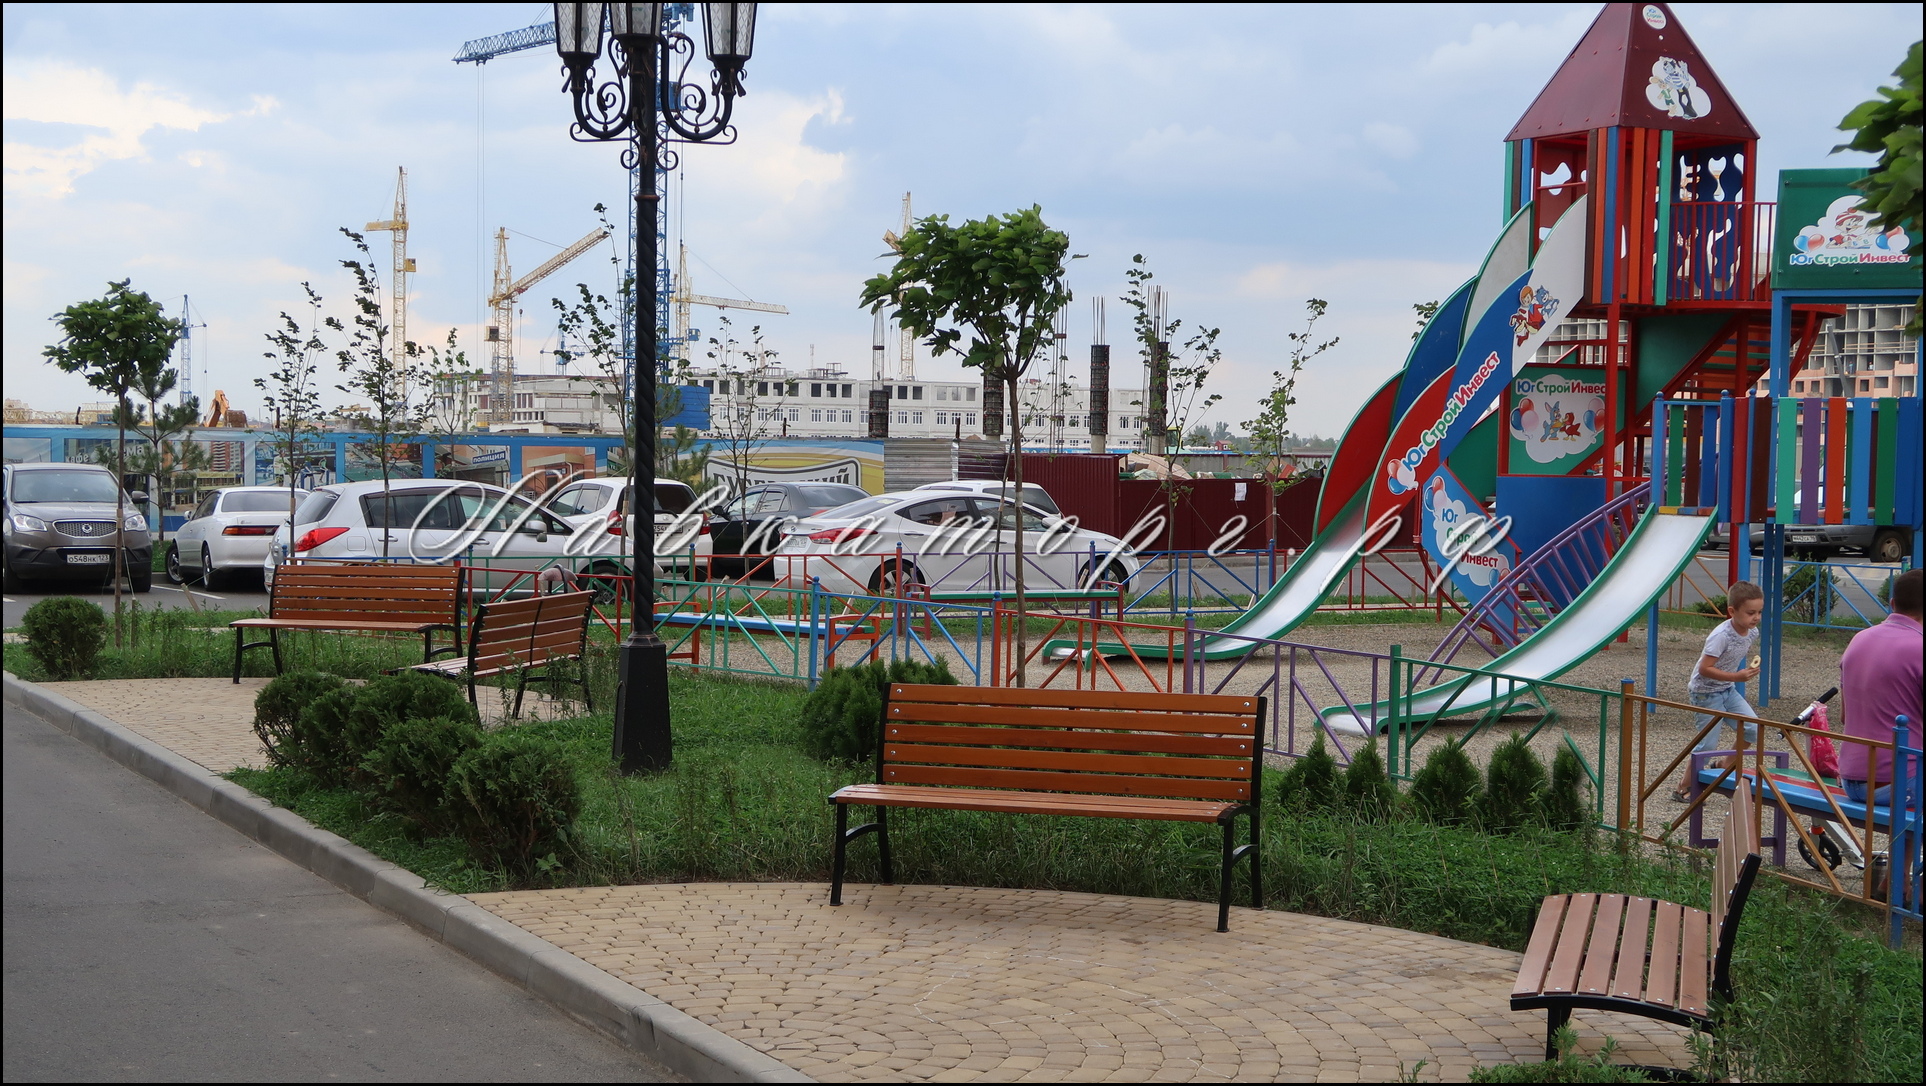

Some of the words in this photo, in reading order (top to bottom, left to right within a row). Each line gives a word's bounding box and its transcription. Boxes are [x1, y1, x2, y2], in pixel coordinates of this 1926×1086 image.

[1790, 252, 1911, 266] ЮгСтройИнвест
[1517, 380, 1606, 396] ЮгСтройИнвес
[1401, 352, 1500, 472] ЮгСтройИнвест
[1441, 508, 1459, 523] Юг
[1460, 549, 1499, 568] Инвест
